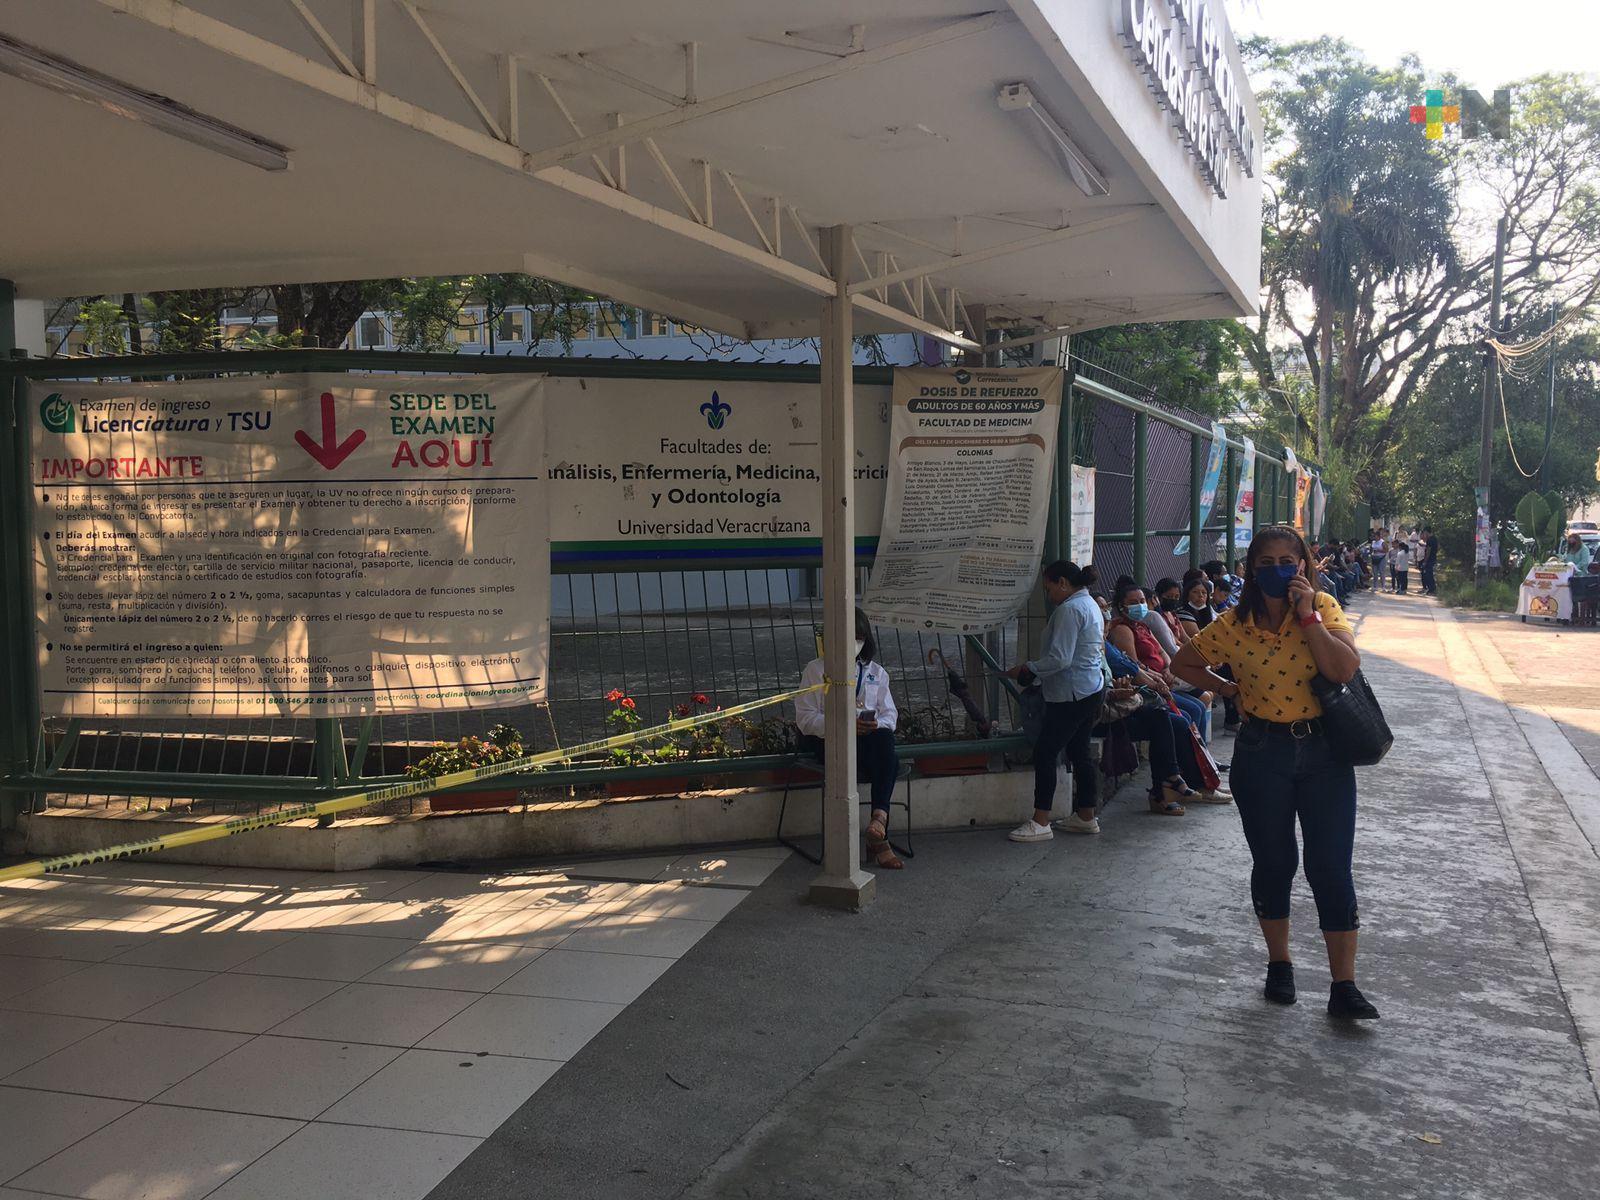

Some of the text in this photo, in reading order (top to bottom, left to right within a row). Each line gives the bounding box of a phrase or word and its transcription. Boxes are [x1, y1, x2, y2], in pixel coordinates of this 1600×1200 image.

[921, 387, 1038, 396] DOSIS DE REFUERZO
[80, 398, 210, 414] Examen de ingreso
[390, 394, 496, 411] SEDE DEL
[916, 402, 958, 410] ADULTOS
[988, 400, 1012, 410] AÑOS
[1021, 401, 1040, 410] MÁS
[82, 411, 271, 433] Licenciatura y TSU
[391, 416, 495, 435] EXAMEN
[919, 419, 971, 427] FACULTAD
[989, 418, 1032, 426] MEDICINA
[392, 433, 493, 468] AQUÍ
[661, 439, 771, 454] Facultades de:
[42, 456, 204, 479] IMPORTANTE
[622, 464, 732, 482] Enfermería,
[736, 465, 820, 482] Medicina,
[103, 492, 137, 502] engañar
[141, 494, 154, 502] por
[157, 493, 196, 502] personas
[199, 492, 215, 501] que
[229, 492, 269, 500] aseguren
[286, 489, 314, 500] lugar,
[328, 489, 343, 497] UV
[361, 488, 393, 496] ofrece
[395, 487, 429, 498] ningún
[475, 488, 515, 496] prepara-
[651, 488, 781, 508] y Odontología
[102, 530, 137, 538] Examen
[140, 530, 165, 538] acudir
[187, 530, 208, 538] sede
[210, 531, 216, 539] y
[219, 529, 239, 537] hora
[242, 528, 284, 537] indicados
[312, 528, 365, 536] Credencial
[368, 529, 390, 537] para
[393, 526, 435, 534] Examen.
[618, 518, 810, 535] Universidad Veracruzana
[56, 543, 136, 551] Deberás mostrar:
[136, 592, 154, 601] lápiz
[256, 592, 284, 601] goma,
[287, 590, 341, 600] sacapuntas
[345, 591, 351, 599] y
[355, 587, 411, 597] calculadora
[415, 587, 427, 595] de
[430, 585, 476, 594] funciones
[479, 585, 515, 593] simples
[58, 602, 228, 611] (suma, resta, multiplicación y división).
[64, 613, 116, 623] Únicamente
[118, 615, 142, 624] lápiz
[265, 614, 298, 622] hacerlo
[333, 613, 342, 621] el
[345, 612, 376, 623] riesgo
[379, 612, 391, 620] de
[394, 613, 412, 621] que
[415, 610, 425, 619] tu
[428, 608, 475, 620] respuesta
[64, 624, 97, 634] registre.
[85, 643, 130, 652] permitirá
[145, 643, 183, 652] ingreso
[194, 643, 223, 652] quien:
